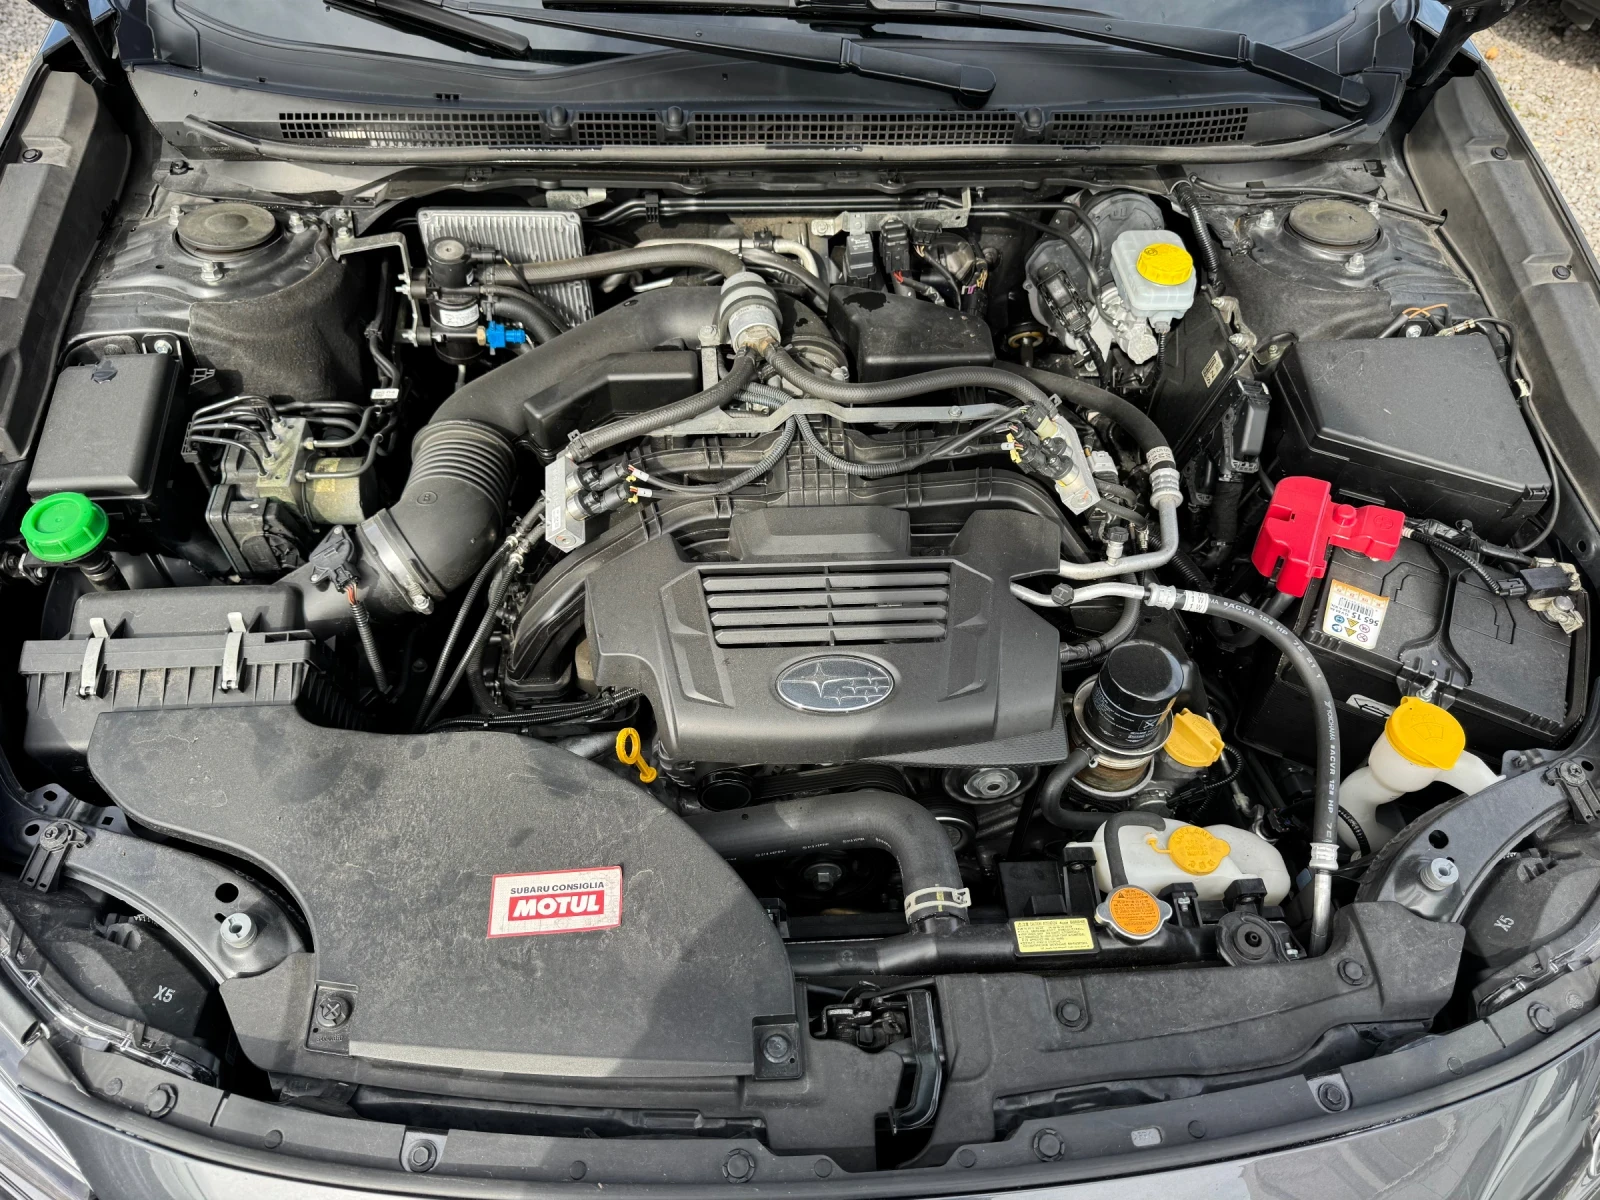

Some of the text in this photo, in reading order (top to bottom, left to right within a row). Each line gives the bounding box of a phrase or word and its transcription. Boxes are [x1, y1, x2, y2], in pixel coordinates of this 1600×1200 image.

[1351, 612, 1380, 627] 565 15
[1275, 625, 1288, 635] HP
[510, 881, 604, 895] SUBARU CONSIGLIA
[512, 894, 600, 918] MOTUL
[1493, 914, 1515, 933] X5
[152, 984, 176, 1003] X5
